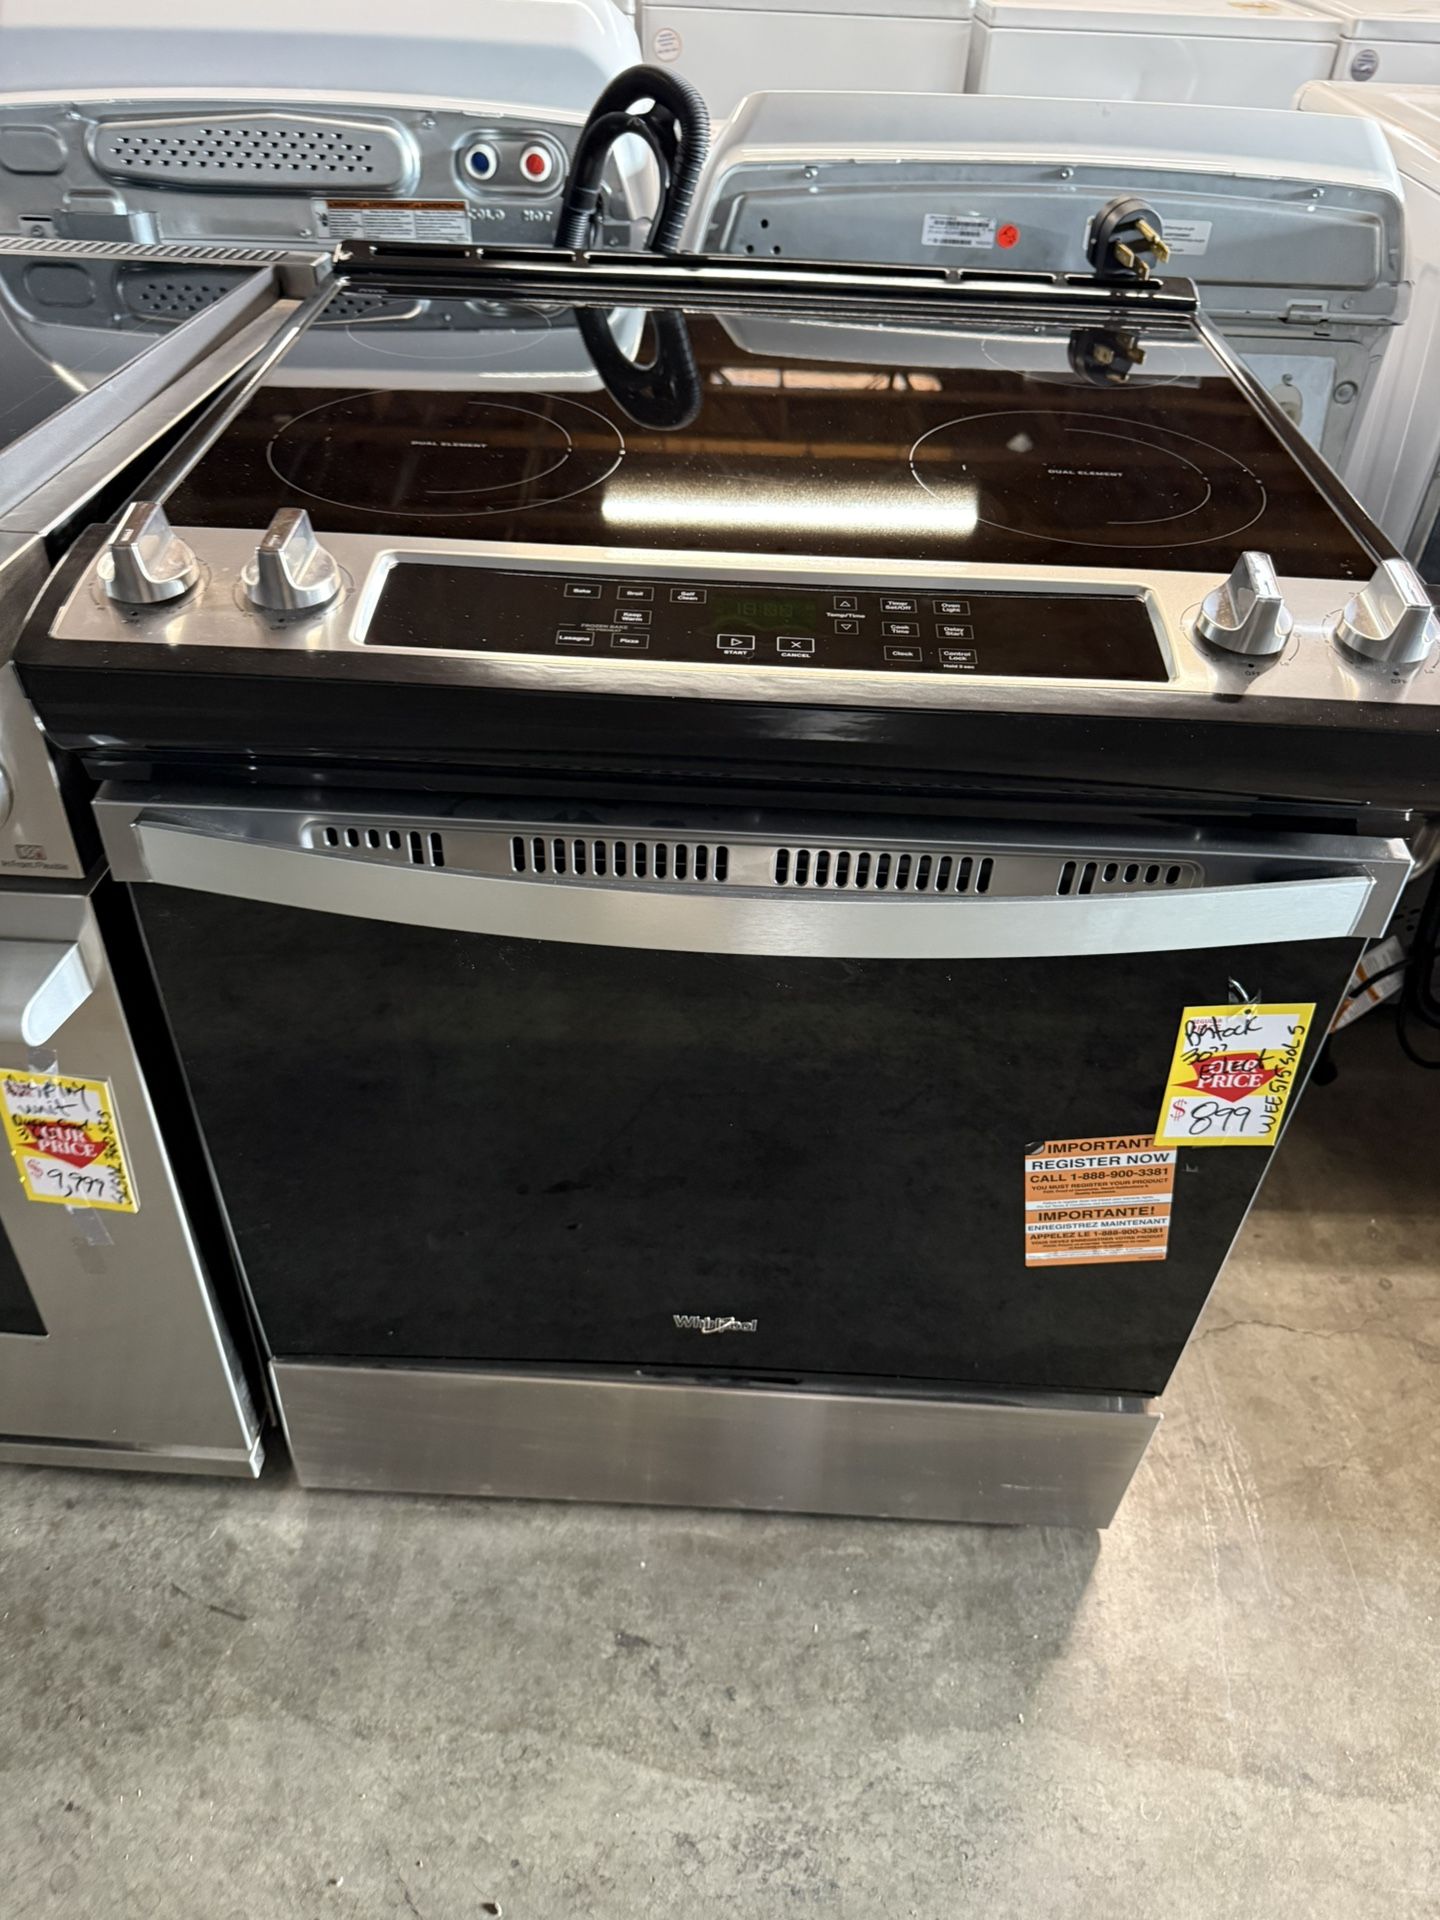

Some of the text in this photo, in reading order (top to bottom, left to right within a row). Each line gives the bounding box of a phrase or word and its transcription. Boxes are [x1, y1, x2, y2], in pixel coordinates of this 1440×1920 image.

[1196, 1074, 1264, 1089] PRICE
[1170, 1099, 1252, 1136] $ 899
[37, 1140, 98, 1158] PRICE
[1032, 1153, 1170, 1171] REGISTER NOW
[1030, 1168, 1169, 1183] CALL 1-888-900-3381
[1038, 1206, 1155, 1222] IMPORTANTE!
[1027, 1217, 1168, 1232] ENREGISTREZ MAINTENANT
[1030, 1231, 1076, 1240] APPELEZ
